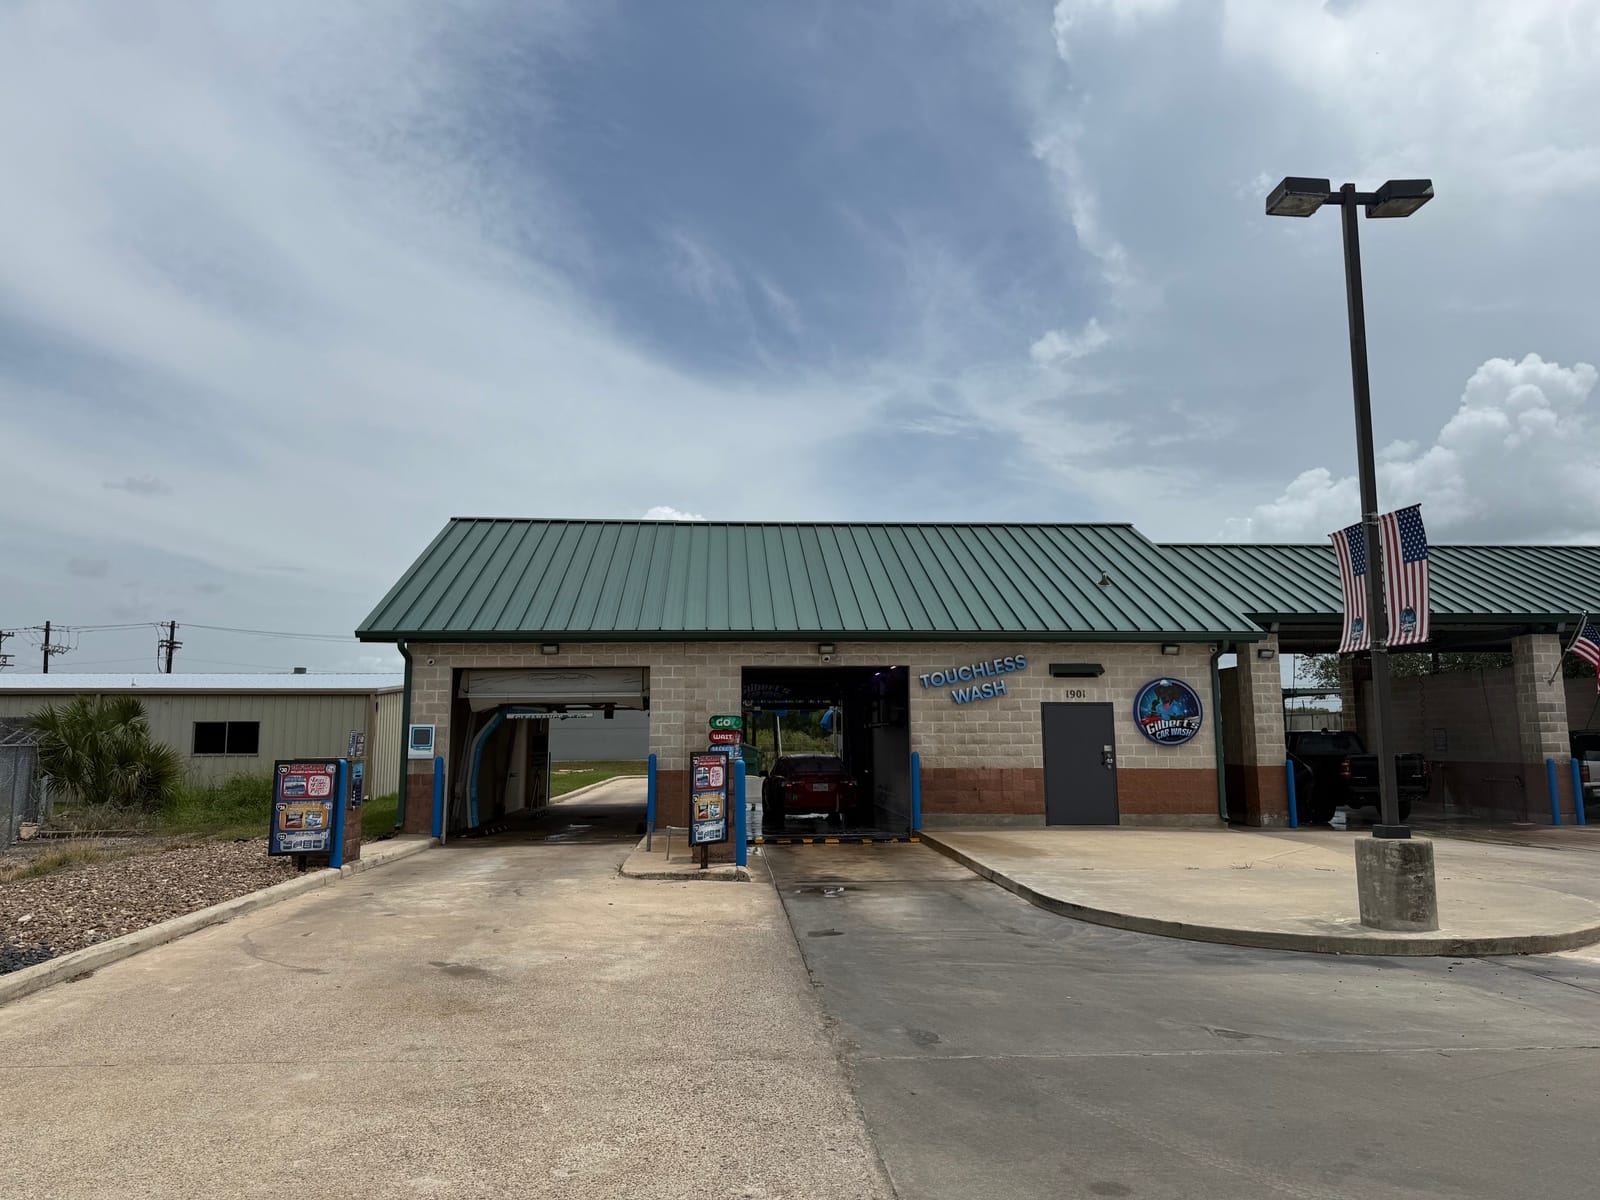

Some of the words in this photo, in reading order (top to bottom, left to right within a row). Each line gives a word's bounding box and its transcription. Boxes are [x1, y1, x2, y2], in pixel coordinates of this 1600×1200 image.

[919, 654, 1028, 689] TOUCHLESS
[951, 679, 1008, 705] WASH
[1065, 689, 1086, 699] 1901
[716, 718, 731, 727] GO
[1146, 719, 1200, 735] Gilbert's
[1156, 729, 1170, 739] CAR
[1170, 727, 1193, 737] WASH
